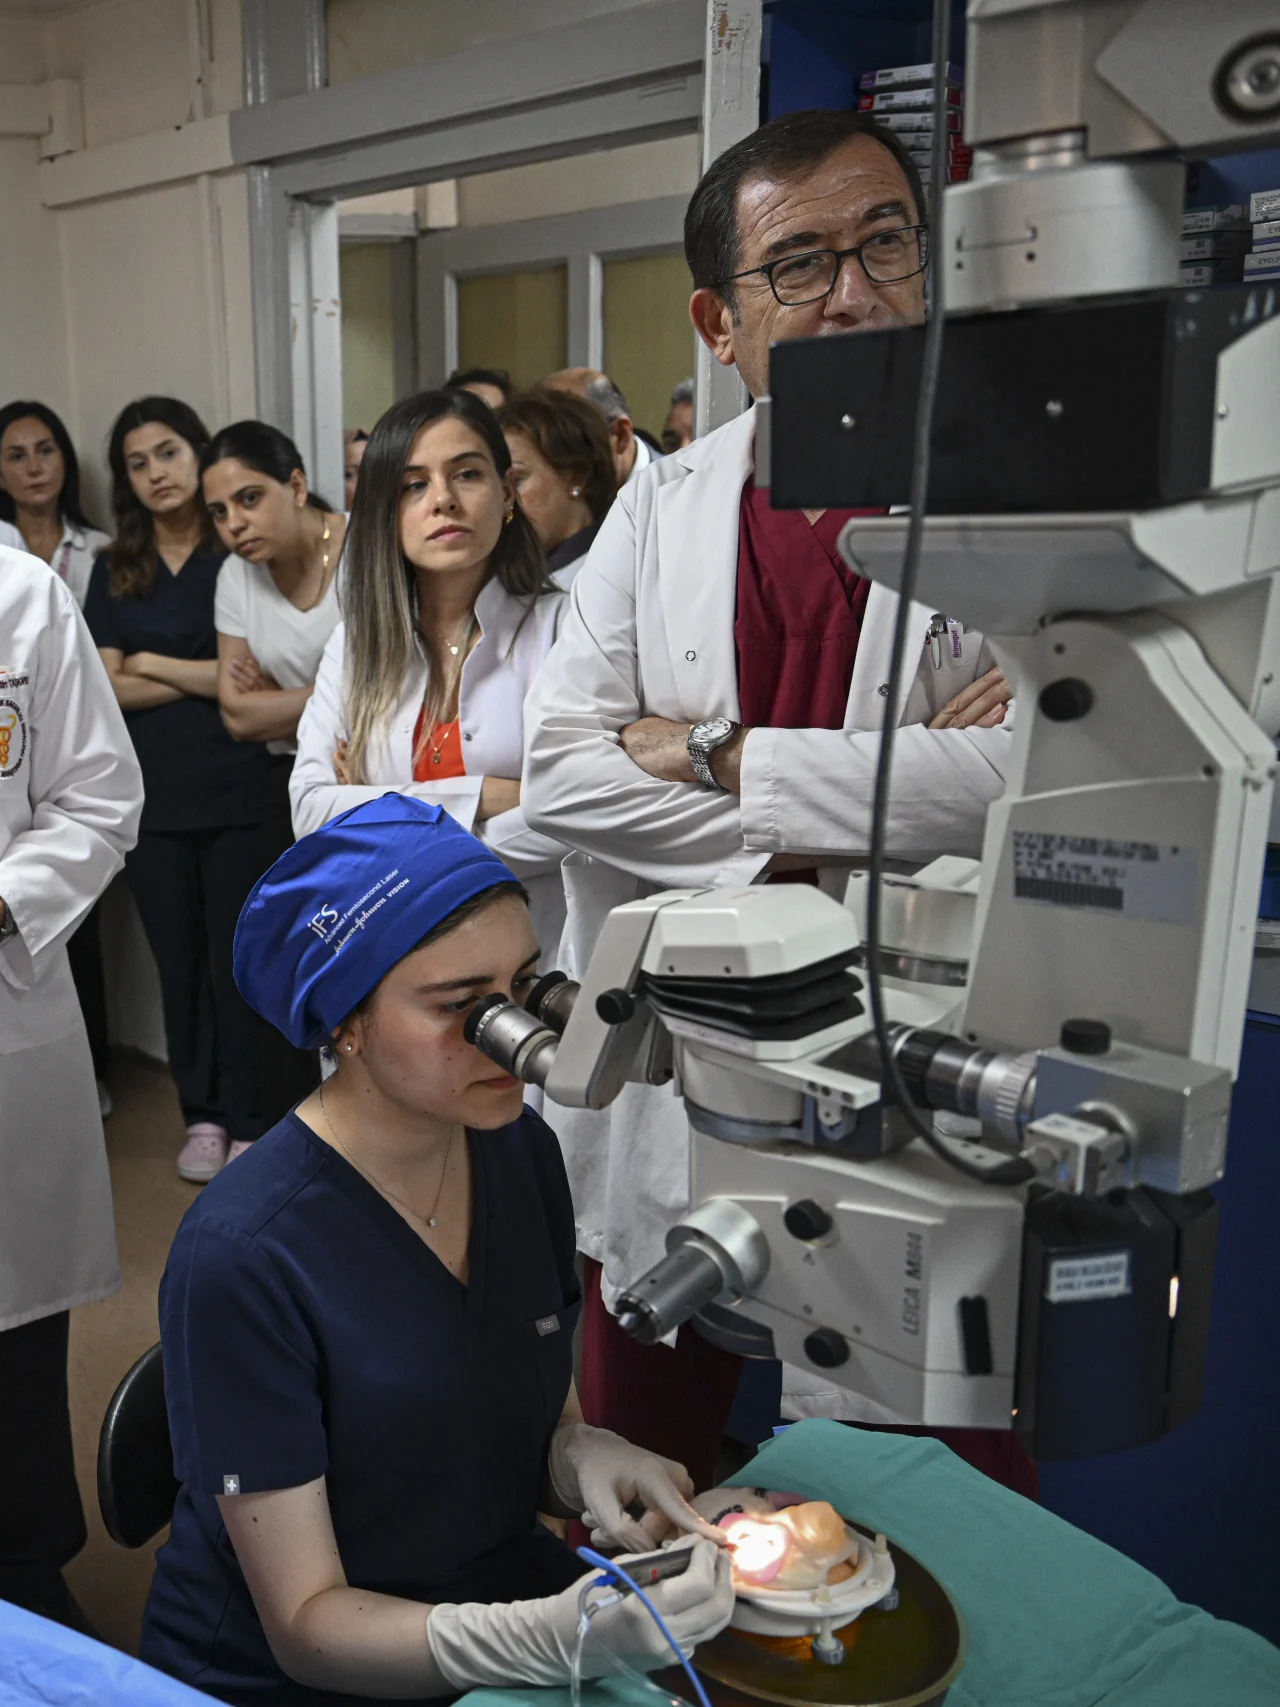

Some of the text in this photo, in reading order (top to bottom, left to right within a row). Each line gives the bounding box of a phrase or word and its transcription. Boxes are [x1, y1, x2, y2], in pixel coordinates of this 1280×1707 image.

[324, 868, 399, 945] Advanced Femtosecond Laser
[386, 877, 410, 898] VISION
